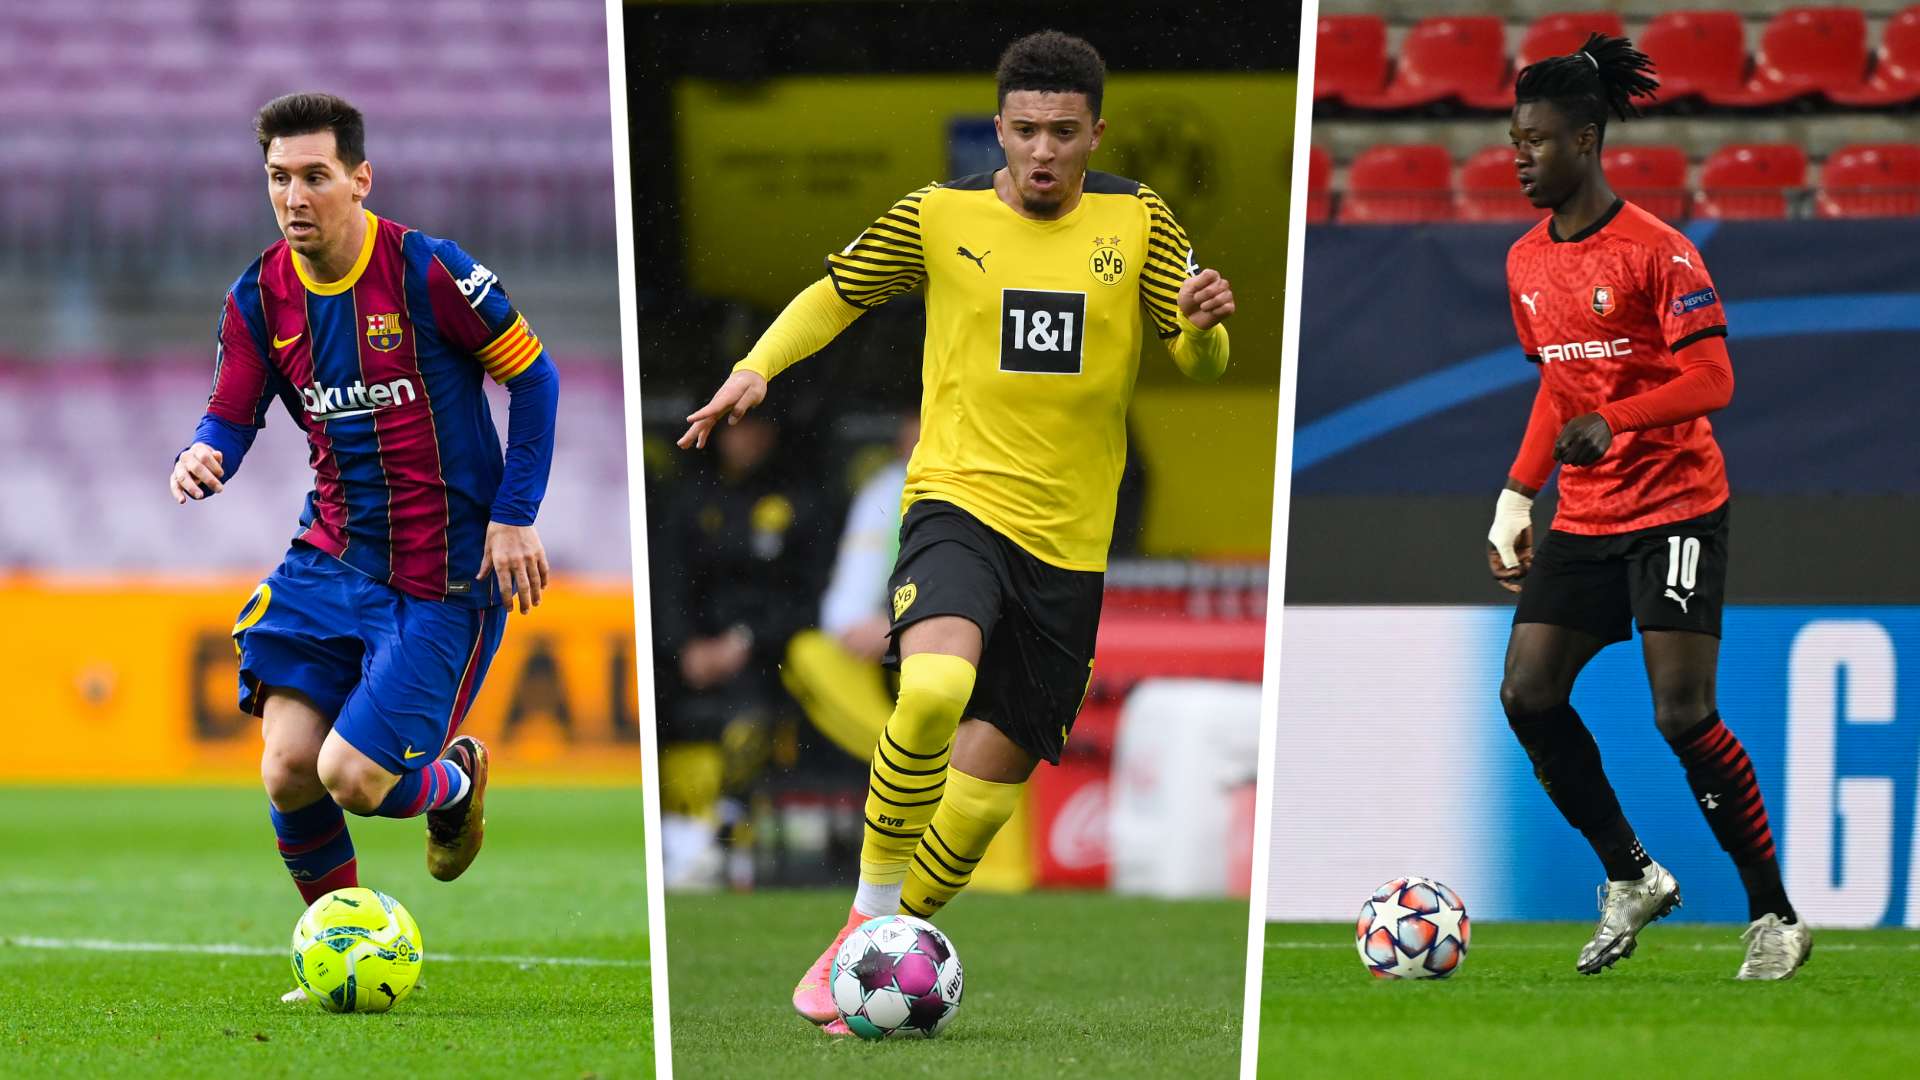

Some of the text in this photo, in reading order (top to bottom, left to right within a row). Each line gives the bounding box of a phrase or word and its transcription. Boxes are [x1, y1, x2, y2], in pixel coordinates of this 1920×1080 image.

[1093, 250, 1123, 275] BVB
[1103, 273, 1115, 282] 09
[1683, 291, 1714, 307] RESPECT
[1009, 309, 1074, 352] 1&1
[301, 378, 416, 414] akuten
[1666, 535, 1701, 590] 10
[878, 814, 905, 828] BVB
